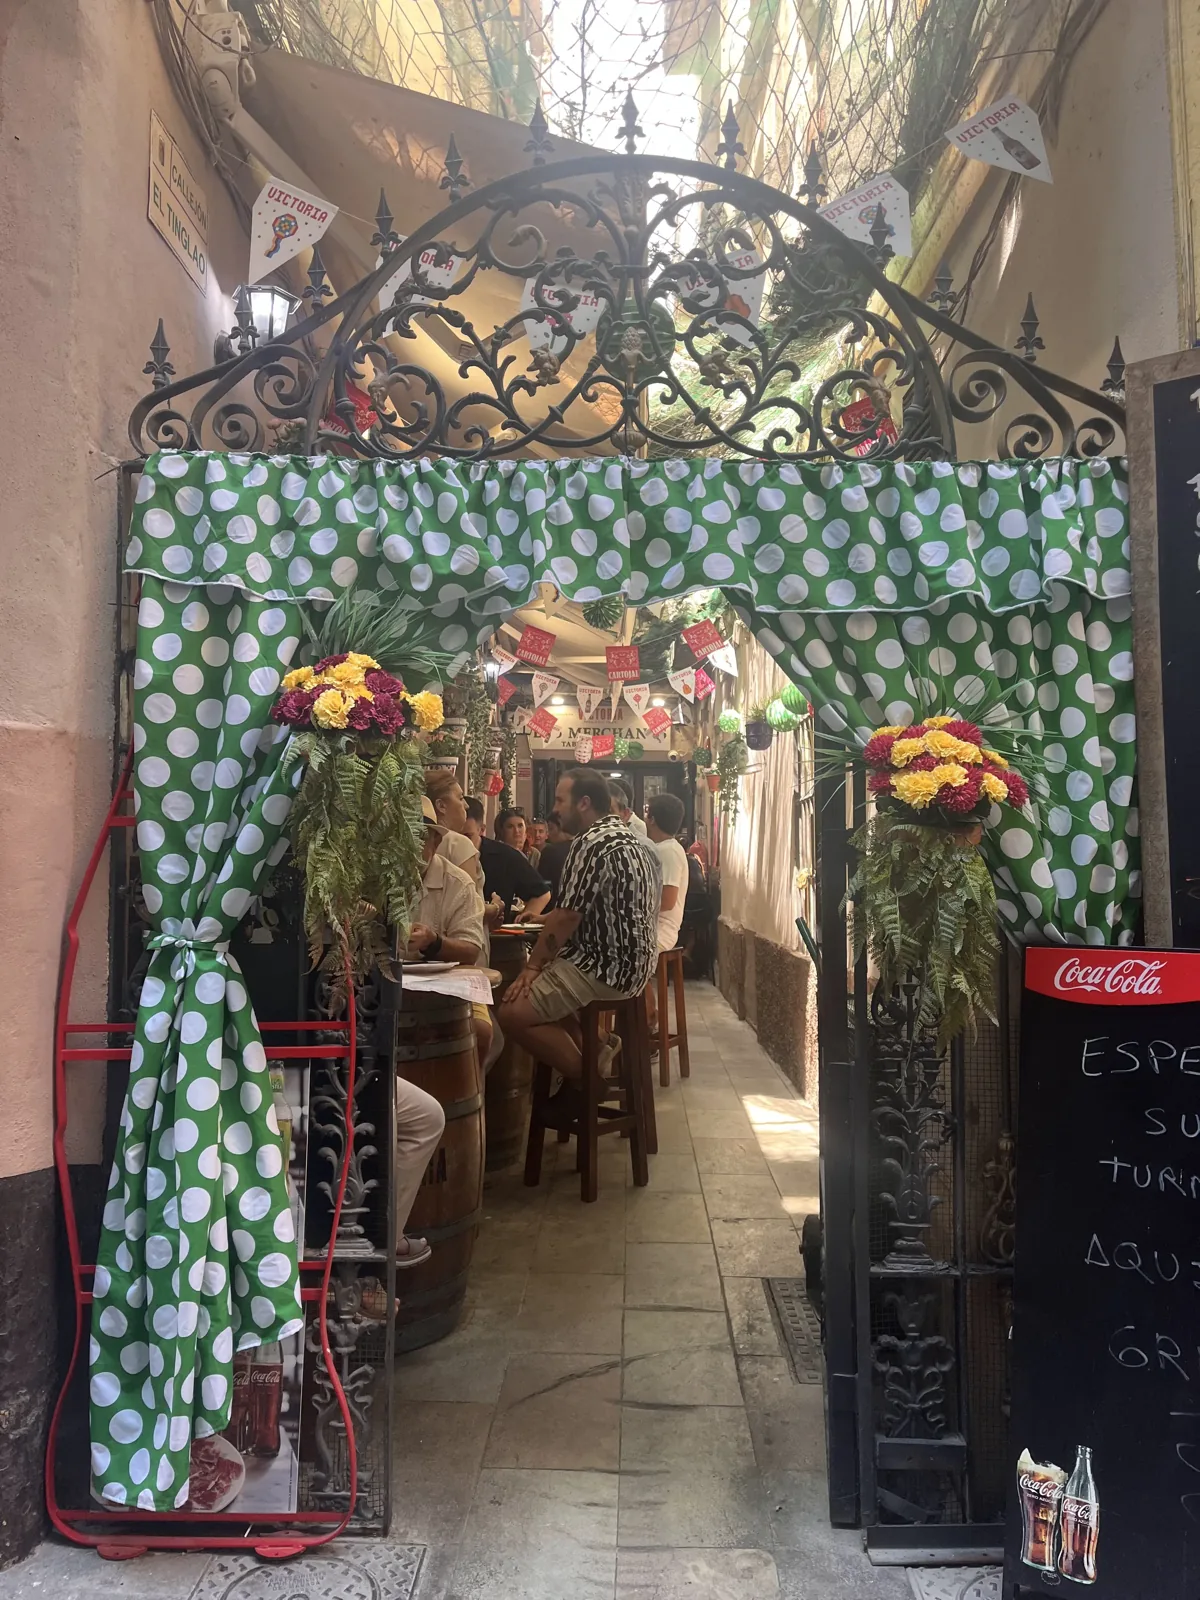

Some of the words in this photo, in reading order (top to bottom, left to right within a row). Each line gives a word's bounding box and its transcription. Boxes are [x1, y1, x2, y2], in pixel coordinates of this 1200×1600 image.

[955, 102, 1021, 144] VICTORIA
[267, 186, 328, 223] VICTORIA
[824, 181, 893, 220] VICTORIA
[153, 181, 164, 217] EL
[167, 203, 206, 275] TINGLAO
[516, 648, 547, 665] CARTOJAL
[608, 670, 639, 679] CARTOJAL
[1053, 957, 1168, 995] Coca-Cola
[250, 1370, 280, 1383] Coca-Cola
[1019, 1473, 1064, 1499] Coca-Cola
